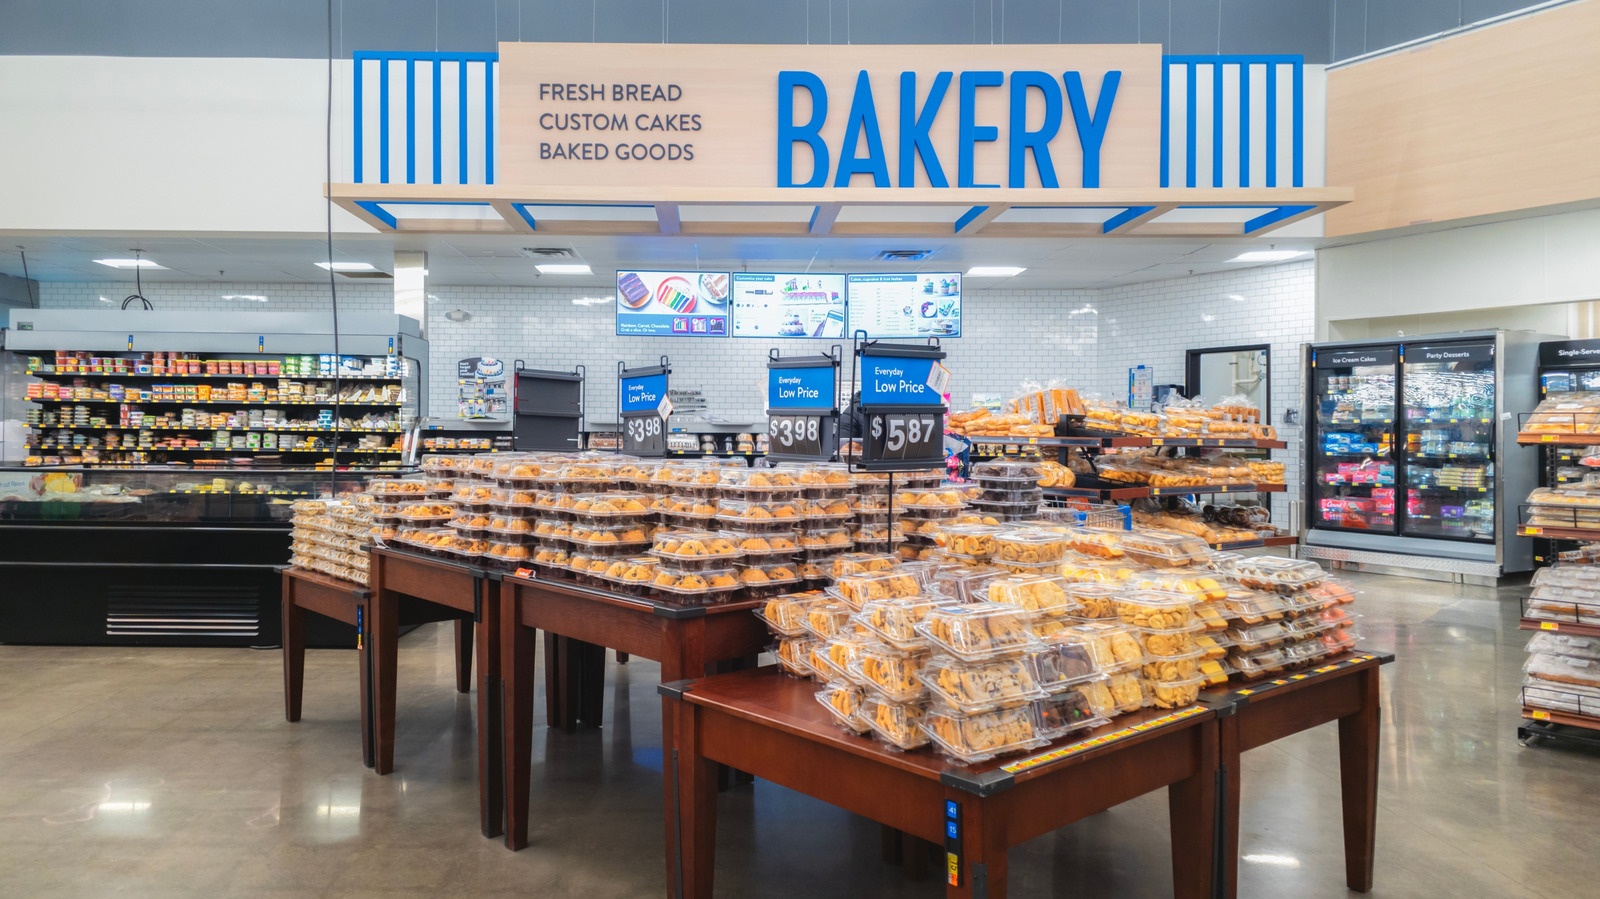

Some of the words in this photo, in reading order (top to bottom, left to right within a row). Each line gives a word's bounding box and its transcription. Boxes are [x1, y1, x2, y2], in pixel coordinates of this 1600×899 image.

[539, 83, 606, 102] FRESH
[612, 83, 683, 102] BREAD
[539, 113, 629, 132] CUSTOM
[634, 113, 703, 132] CAKES
[777, 69, 1122, 188] BAKERY
[540, 142, 609, 161] BAKED
[615, 142, 695, 161] GOODS
[1358, 355, 1377, 363] Cakes
[1426, 352, 1442, 361] Party
[1443, 351, 1470, 359] Desserts
[874, 367, 904, 377] Everyday
[778, 377, 802, 385] Everyday
[875, 380, 896, 393] Low
[899, 380, 925, 393] Price
[628, 394, 640, 403] Low
[641, 392, 657, 402] Price
[778, 387, 796, 398] Low
[797, 386, 819, 398] Price
[950, 825, 957, 834] 15
